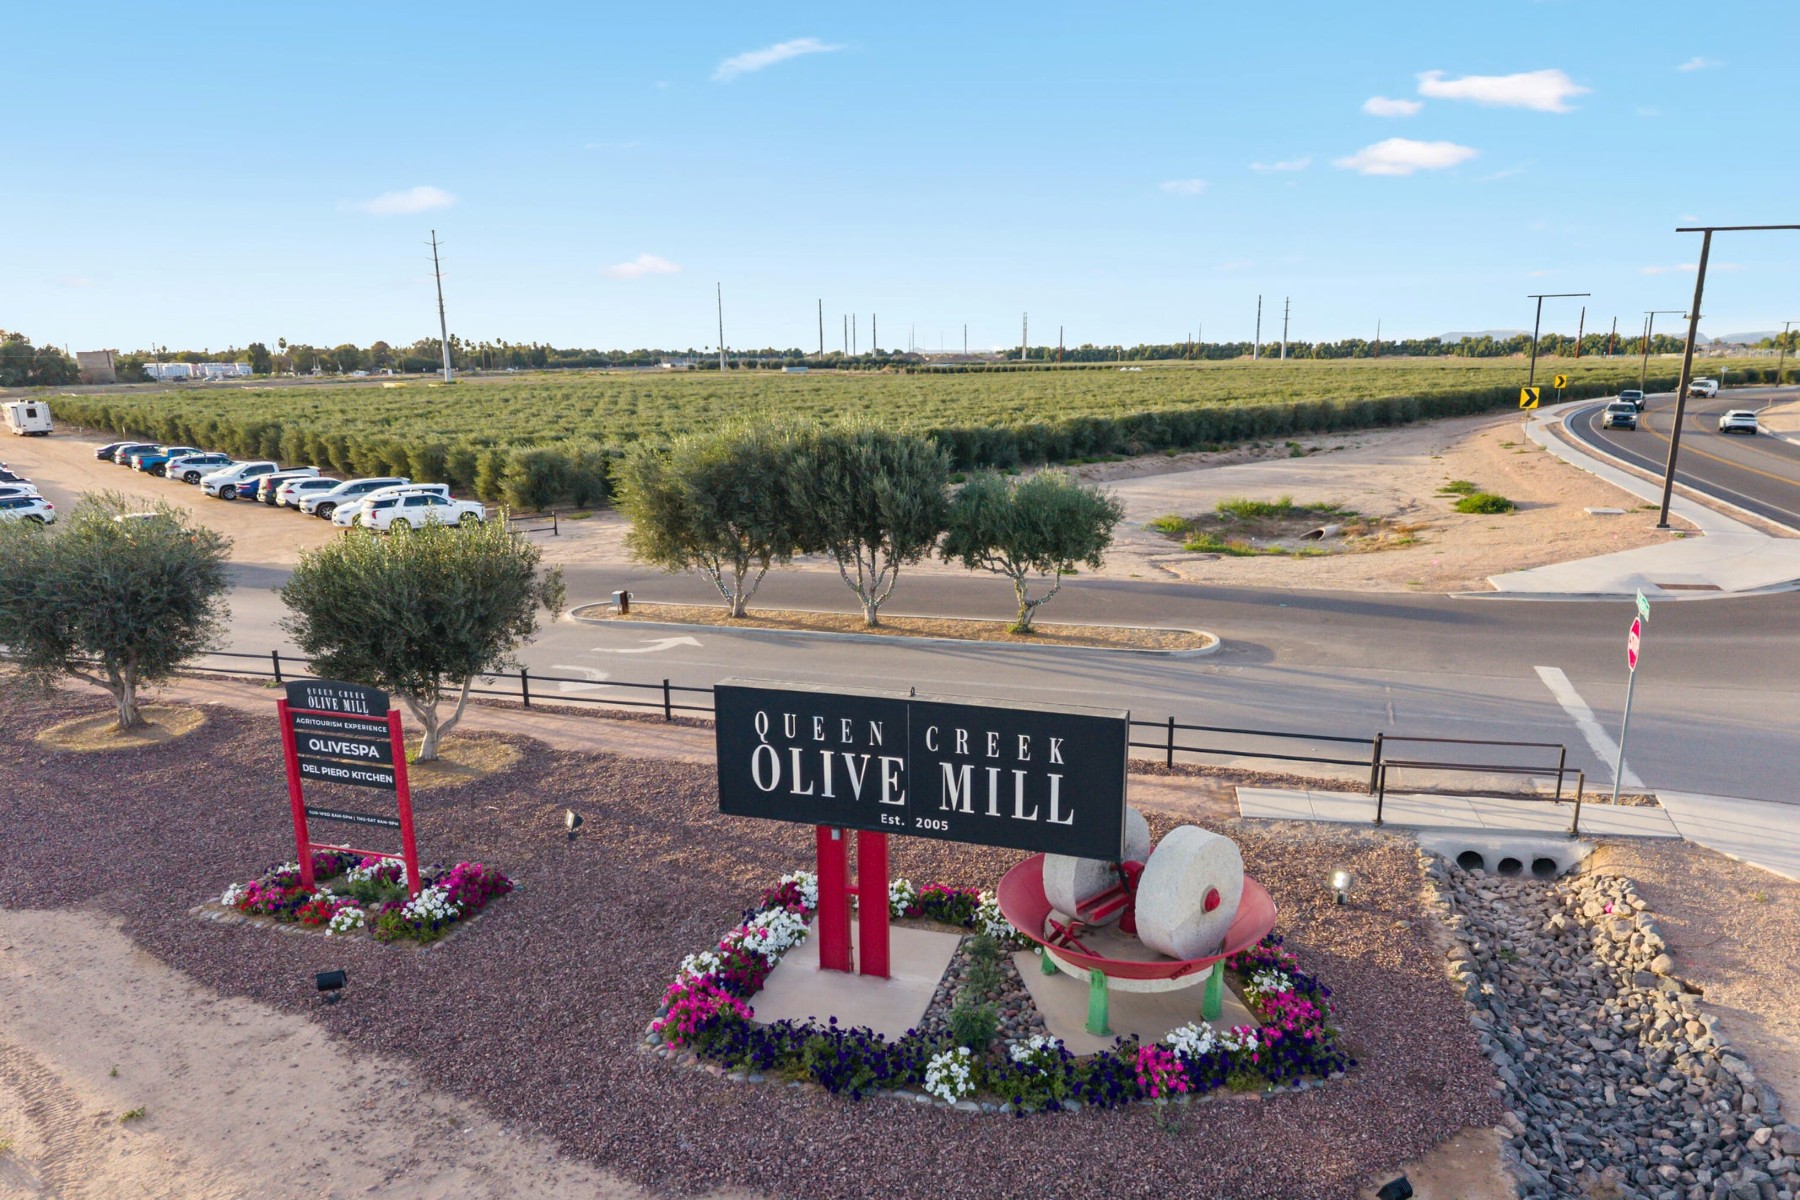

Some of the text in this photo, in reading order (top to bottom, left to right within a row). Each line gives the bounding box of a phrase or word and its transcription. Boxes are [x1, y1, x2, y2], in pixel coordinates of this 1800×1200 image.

[339, 690, 365, 699] CREEK
[308, 696, 368, 713] OLIVE MILL
[296, 718, 387, 733] AGRITOURISM EXPERIENCE
[754, 711, 1064, 765] QUEEN CREEK
[309, 739, 379, 758] OLIVESPA
[302, 764, 393, 783] DEL PIERO KITCHEN
[751, 744, 1074, 825] OLIVE MILL
[880, 813, 949, 831] Est. 2005
